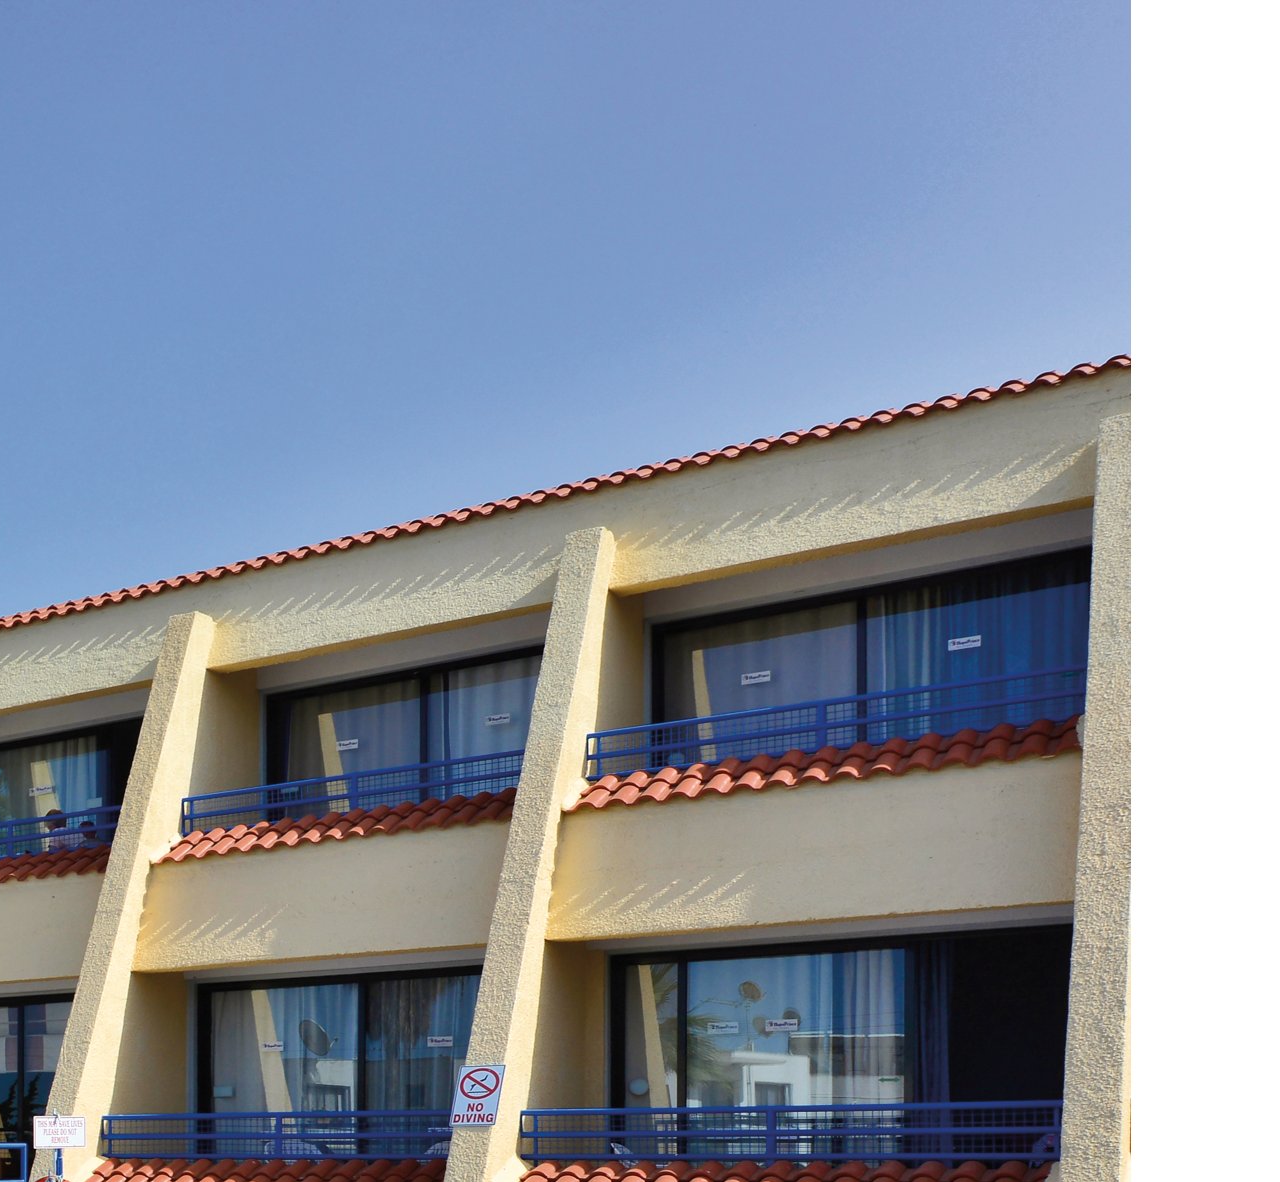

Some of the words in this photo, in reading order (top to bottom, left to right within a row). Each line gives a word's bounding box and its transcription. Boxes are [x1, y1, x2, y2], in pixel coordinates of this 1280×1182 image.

[466, 1102, 484, 1113] NO
[453, 1113, 495, 1124] DIVING
[43, 1128, 59, 1136] PLEASE
[60, 1128, 68, 1136] DO
